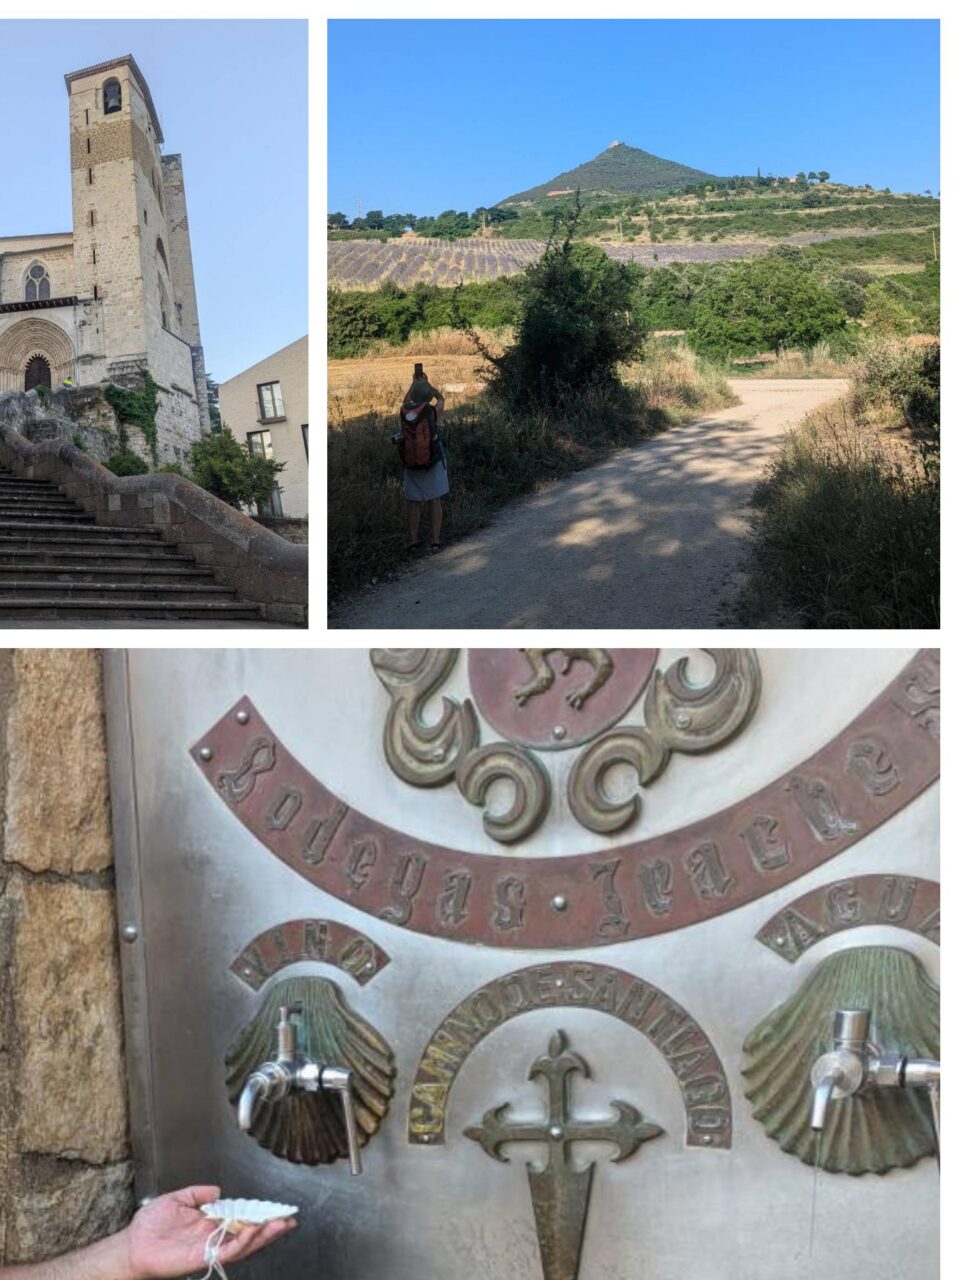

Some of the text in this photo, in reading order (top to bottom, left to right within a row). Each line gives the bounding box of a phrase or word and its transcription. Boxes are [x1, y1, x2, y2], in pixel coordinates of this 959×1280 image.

[241, 919, 378, 978] VINO
[410, 983, 505, 1134] CAMINO
[568, 966, 728, 1131] SANTIAGO
